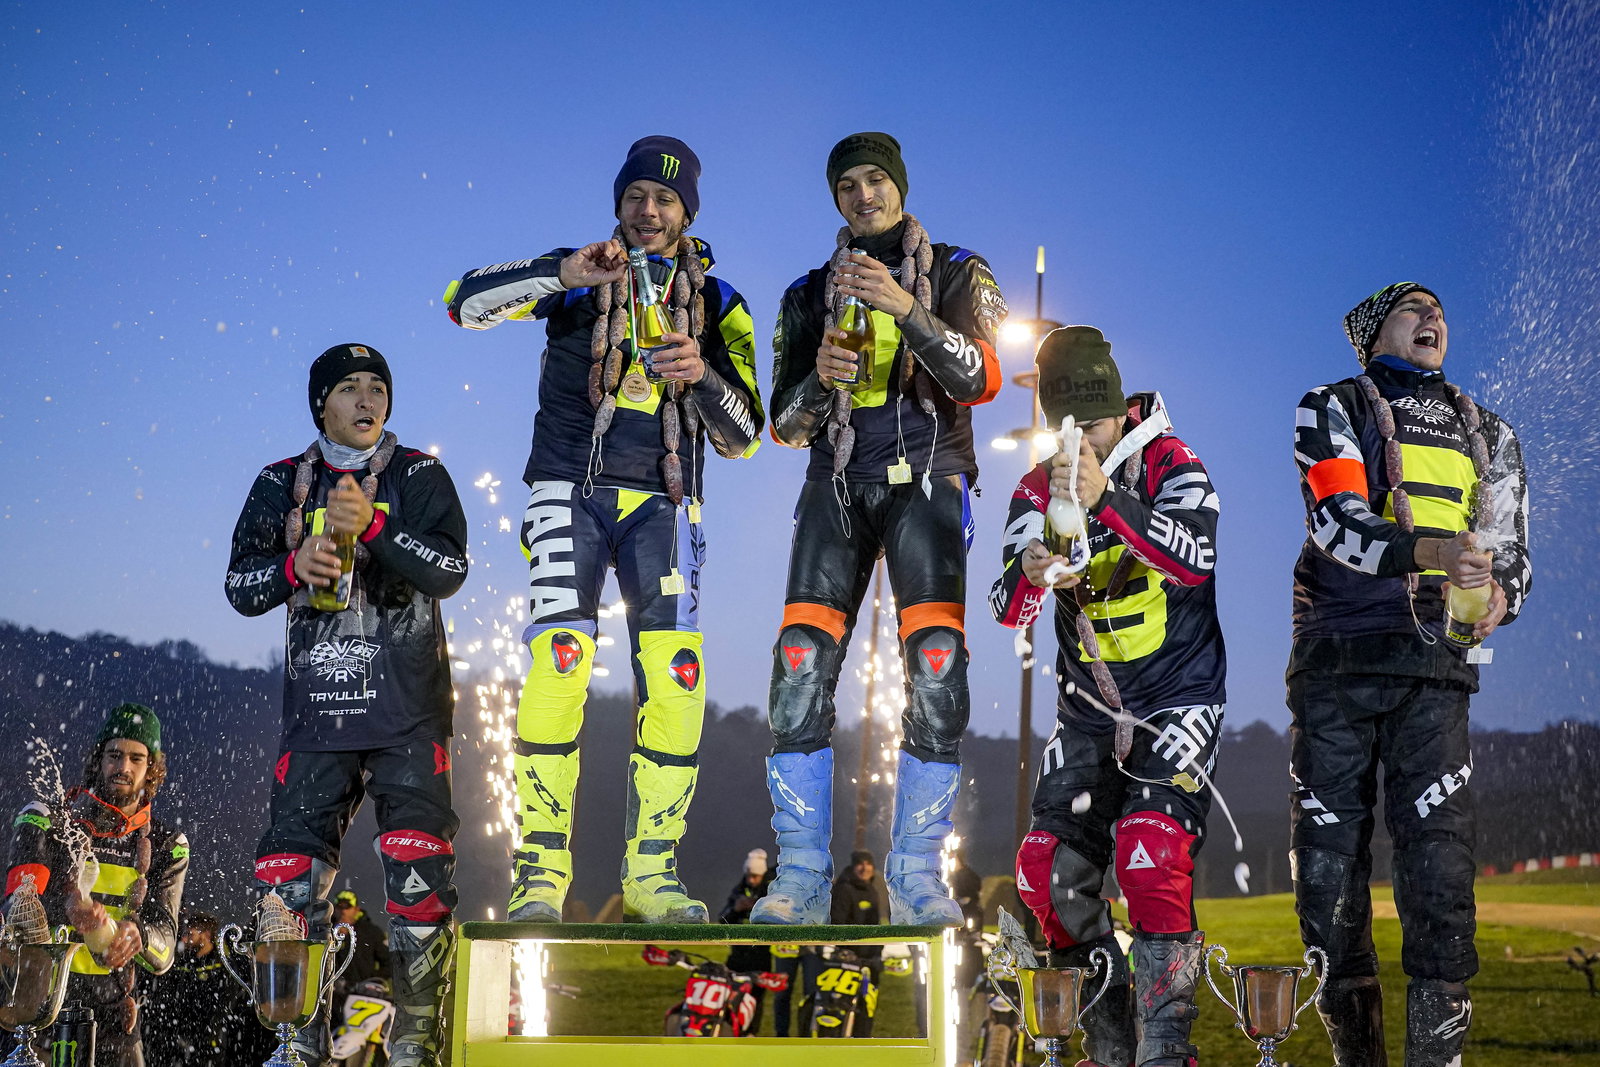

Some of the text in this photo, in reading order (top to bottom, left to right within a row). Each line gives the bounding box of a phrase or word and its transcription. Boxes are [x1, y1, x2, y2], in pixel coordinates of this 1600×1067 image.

[476, 292, 534, 323] DAINESE
[719, 384, 757, 441] YAMAHA
[1403, 424, 1462, 442] TAVULLIA
[309, 690, 377, 703] TAVULLIA
[1121, 817, 1178, 836] DAINESE
[385, 836, 443, 853] DAINESE
[685, 981, 728, 1010] 10
[816, 968, 863, 996] 46
[344, 999, 387, 1028] 7
